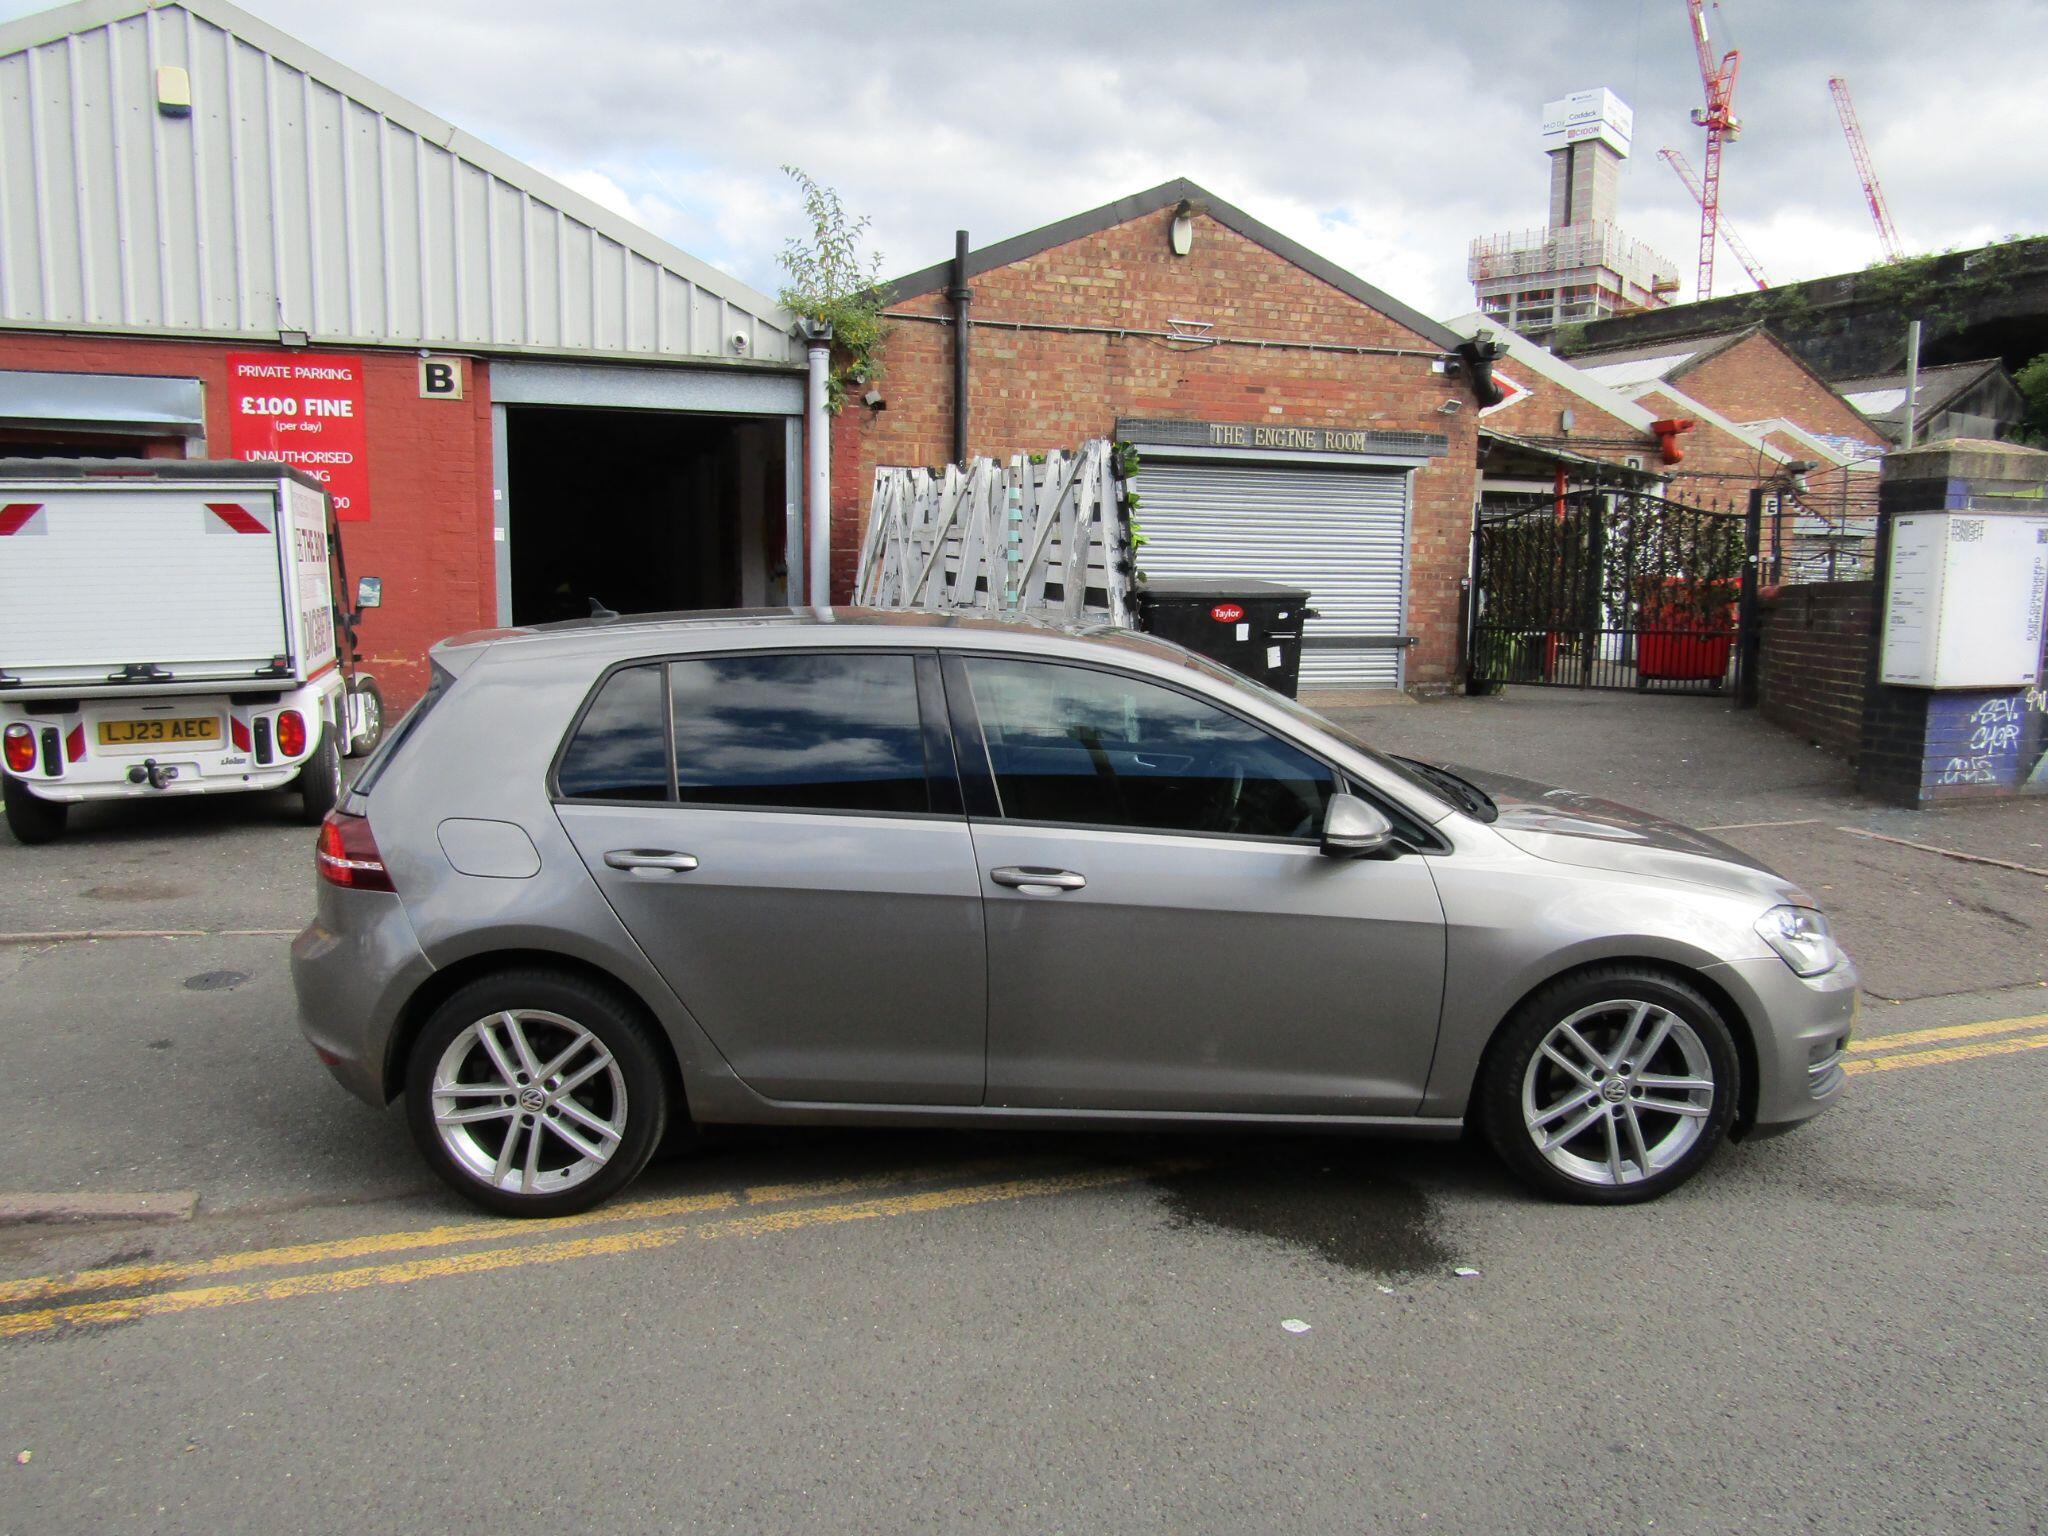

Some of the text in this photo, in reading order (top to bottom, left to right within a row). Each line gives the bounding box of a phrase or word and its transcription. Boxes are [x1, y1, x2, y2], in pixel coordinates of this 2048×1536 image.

[1575, 126, 1600, 136] CIDON
[238, 365, 353, 381] PRIVATE PARKING
[426, 364, 455, 393] B
[241, 397, 353, 417] £100 FINE
[275, 421, 322, 433] (per day)
[1214, 426, 1366, 451] THE ENGINE ROOM
[246, 450, 354, 464] UNAUTHORISED
[1767, 500, 1777, 513] E
[1214, 608, 1240, 620] Taylor
[107, 719, 212, 741] LJ23 AEC
